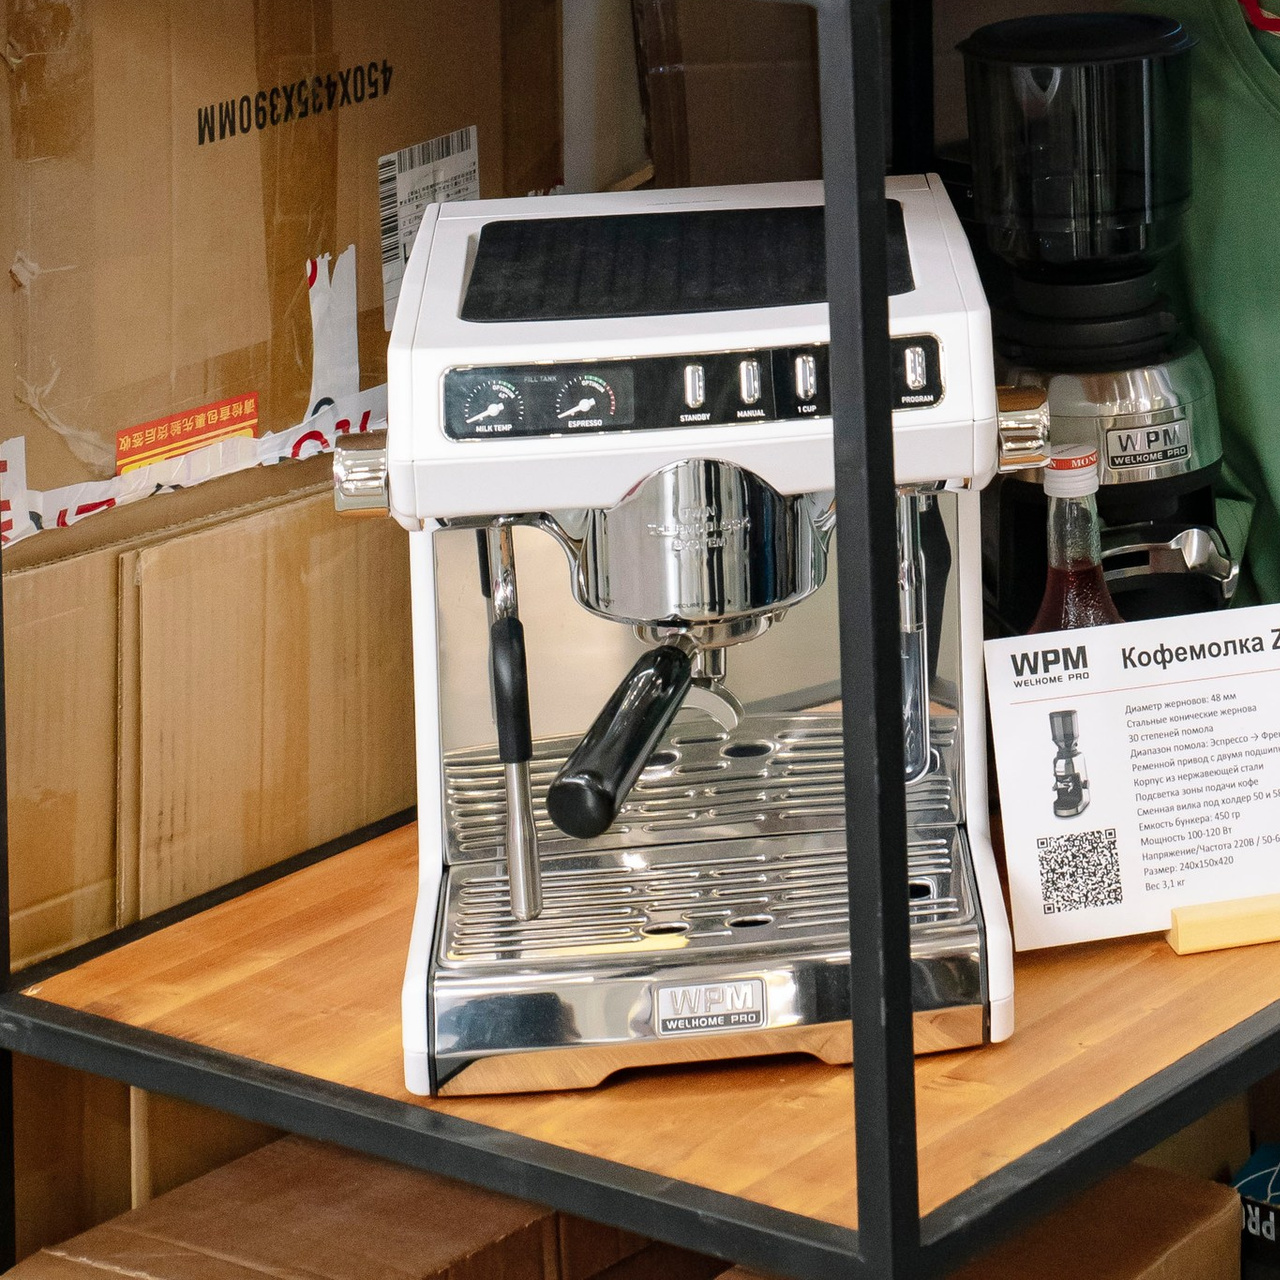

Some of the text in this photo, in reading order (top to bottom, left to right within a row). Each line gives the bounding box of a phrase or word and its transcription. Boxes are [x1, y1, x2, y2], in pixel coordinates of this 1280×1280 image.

[198, 59, 393, 145] 450X435X390MM
[803, 405, 817, 413] CUP
[901, 395, 934, 403] PROGRAM
[568, 419, 603, 428] ESPRESSO
[680, 413, 711, 422] STANDBY
[737, 409, 765, 418] MANUAL
[476, 424, 512, 432] MILK TEMP
[1117, 425, 1180, 452] WPM
[1114, 446, 1186, 465] WELHOME PRO
[1011, 645, 1089, 677] WPM
[1122, 636, 1264, 670] Кофемолка
[1013, 672, 1090, 688] WELHOME PRO
[1125, 703, 1162, 715] Диаметр
[1164, 696, 1209, 709] жерновов:
[1211, 694, 1221, 702] 48
[1127, 704, 1257, 728] Стальные конические жернова
[1129, 725, 1214, 743] 30 степеней помола
[1130, 745, 1172, 759] Диапазон
[1174, 741, 1208, 753] помола:
[1211, 734, 1249, 747] Эспрессо
[1132, 758, 1175, 772] Ременной
[1178, 755, 1209, 768] привод
[1217, 751, 1243, 762] двумя
[1134, 763, 1264, 787] Корпус из нержавеющей стали
[1135, 778, 1259, 802] Подсветка зоны подачи кофе
[1137, 804, 1174, 817] Сменная
[1177, 801, 1201, 811] вилка
[1204, 798, 1220, 809] под
[1221, 793, 1251, 805] холдер
[1254, 792, 1263, 801] 50
[1139, 810, 1240, 832] Емкость бункера: 450 гр
[1141, 827, 1232, 846] Мощность 100-120 Вт
[1142, 841, 1232, 861] Напряжение/Частота
[1234, 838, 1255, 848] 220В
[1144, 864, 1177, 876] Размер:
[1145, 879, 1185, 891] Вес 3,1 кг
[670, 983, 753, 1015] WPM
[666, 1014, 756, 1029] WELHOME PRO
